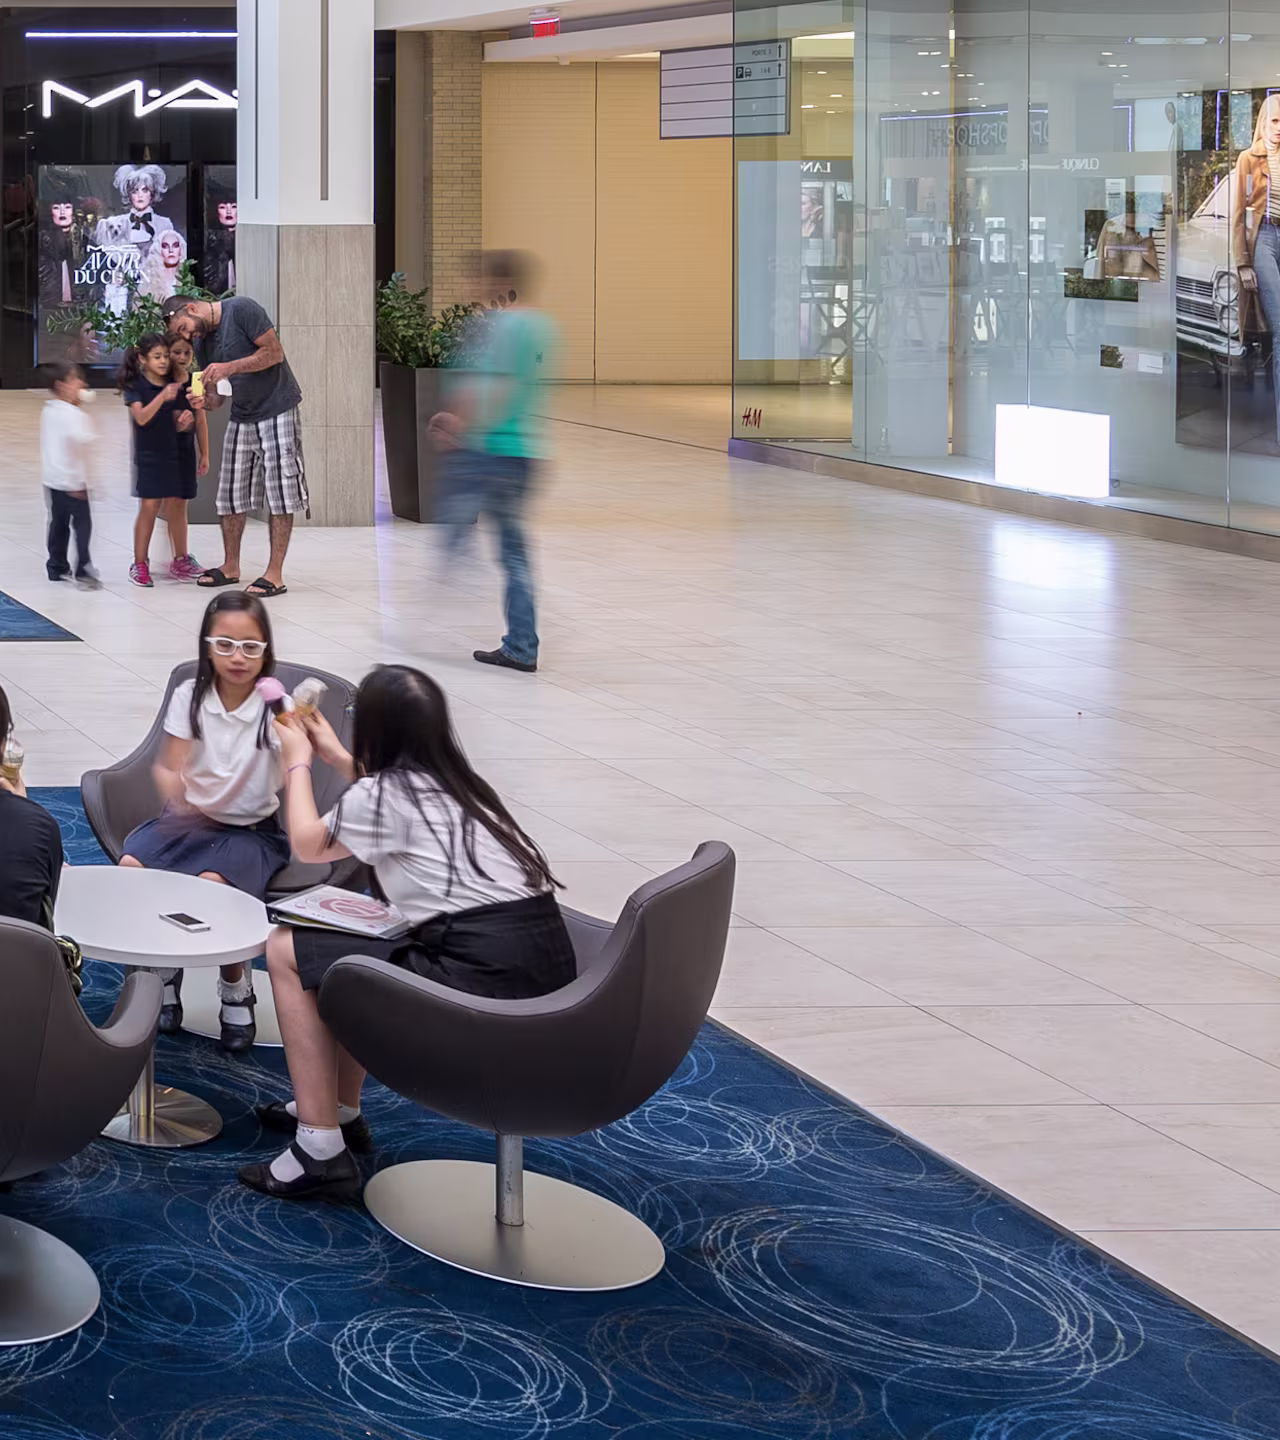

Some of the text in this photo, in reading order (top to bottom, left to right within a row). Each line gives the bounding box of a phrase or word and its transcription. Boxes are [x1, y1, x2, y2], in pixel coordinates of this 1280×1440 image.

[81, 252, 141, 270] AVOIR
[74, 269, 97, 285] DU
[742, 407, 762, 429] H&M
